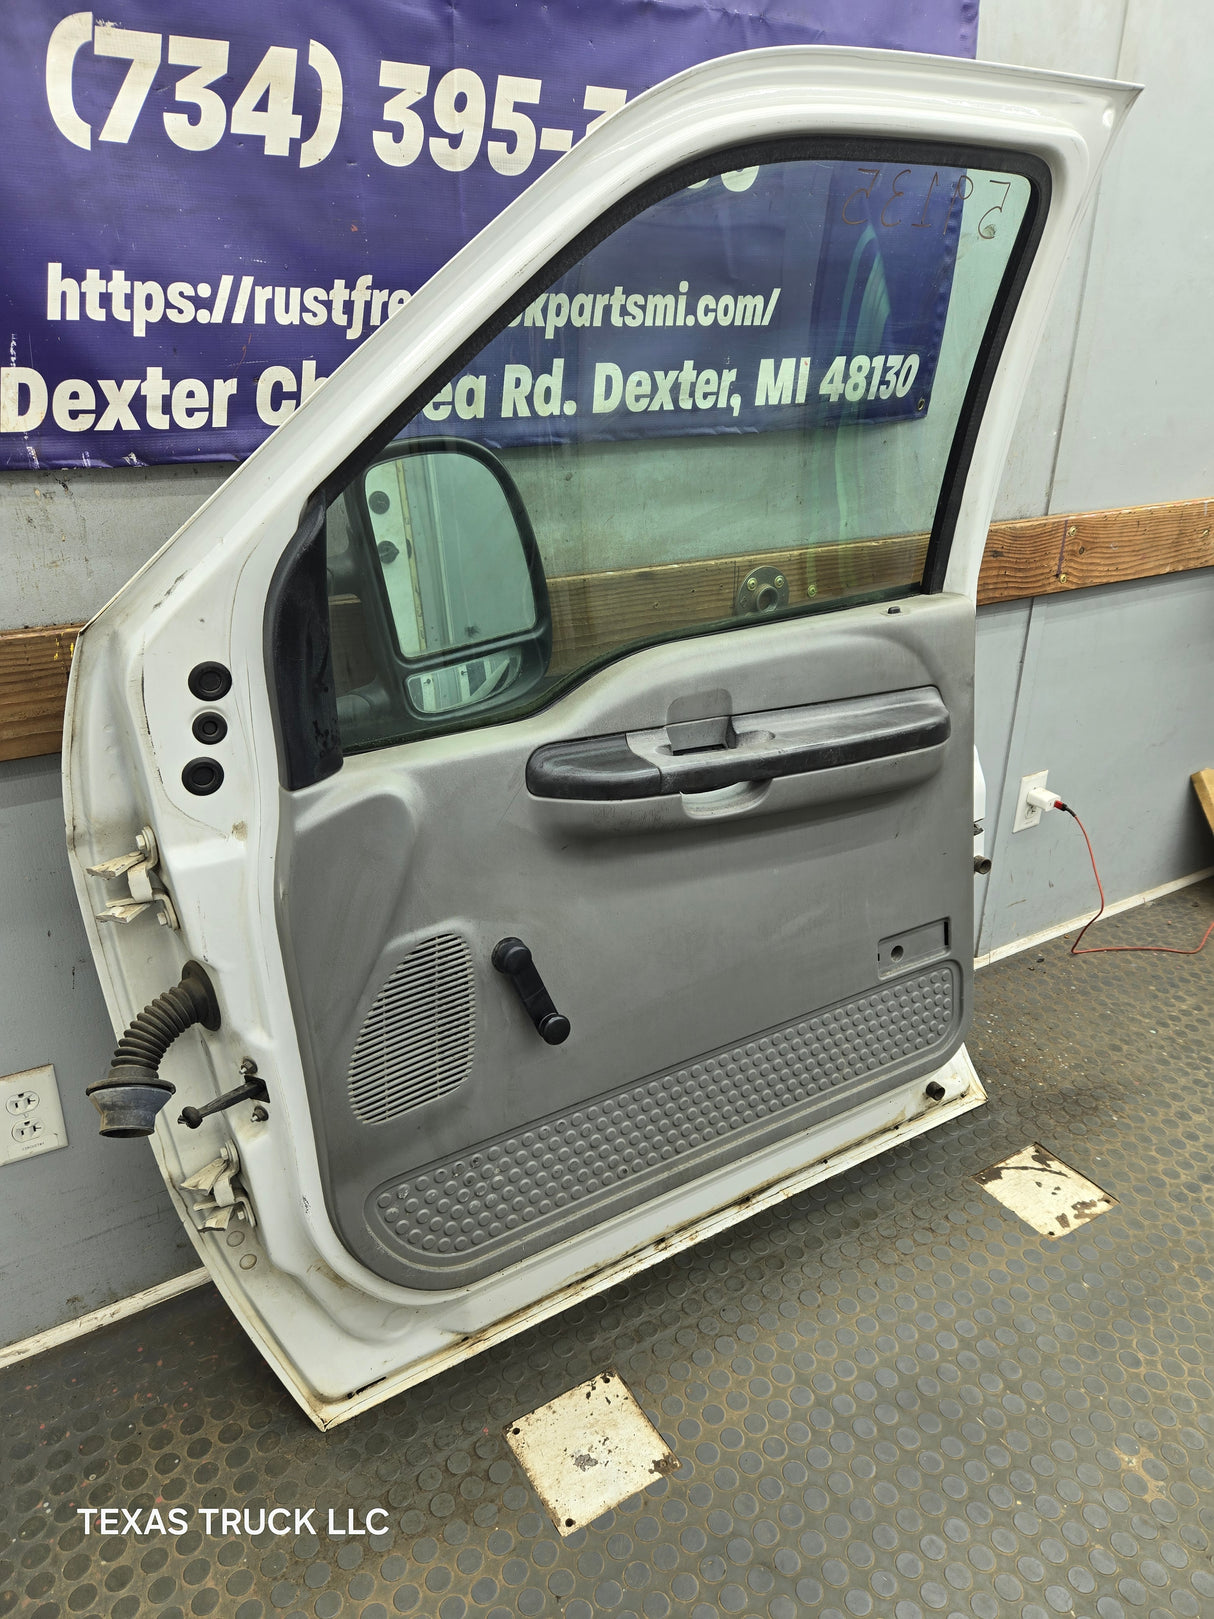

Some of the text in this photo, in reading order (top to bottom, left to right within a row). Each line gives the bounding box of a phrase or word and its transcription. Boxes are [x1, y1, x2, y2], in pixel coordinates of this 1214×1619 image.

[46, 12, 343, 168] (734)
[507, 281, 781, 339] kpartsmi.com/
[0, 366, 237, 432] Dexter
[501, 358, 577, 417] Rd.
[592, 360, 741, 416] Dexter,
[755, 357, 811, 406] MI
[819, 354, 920, 402] 48130
